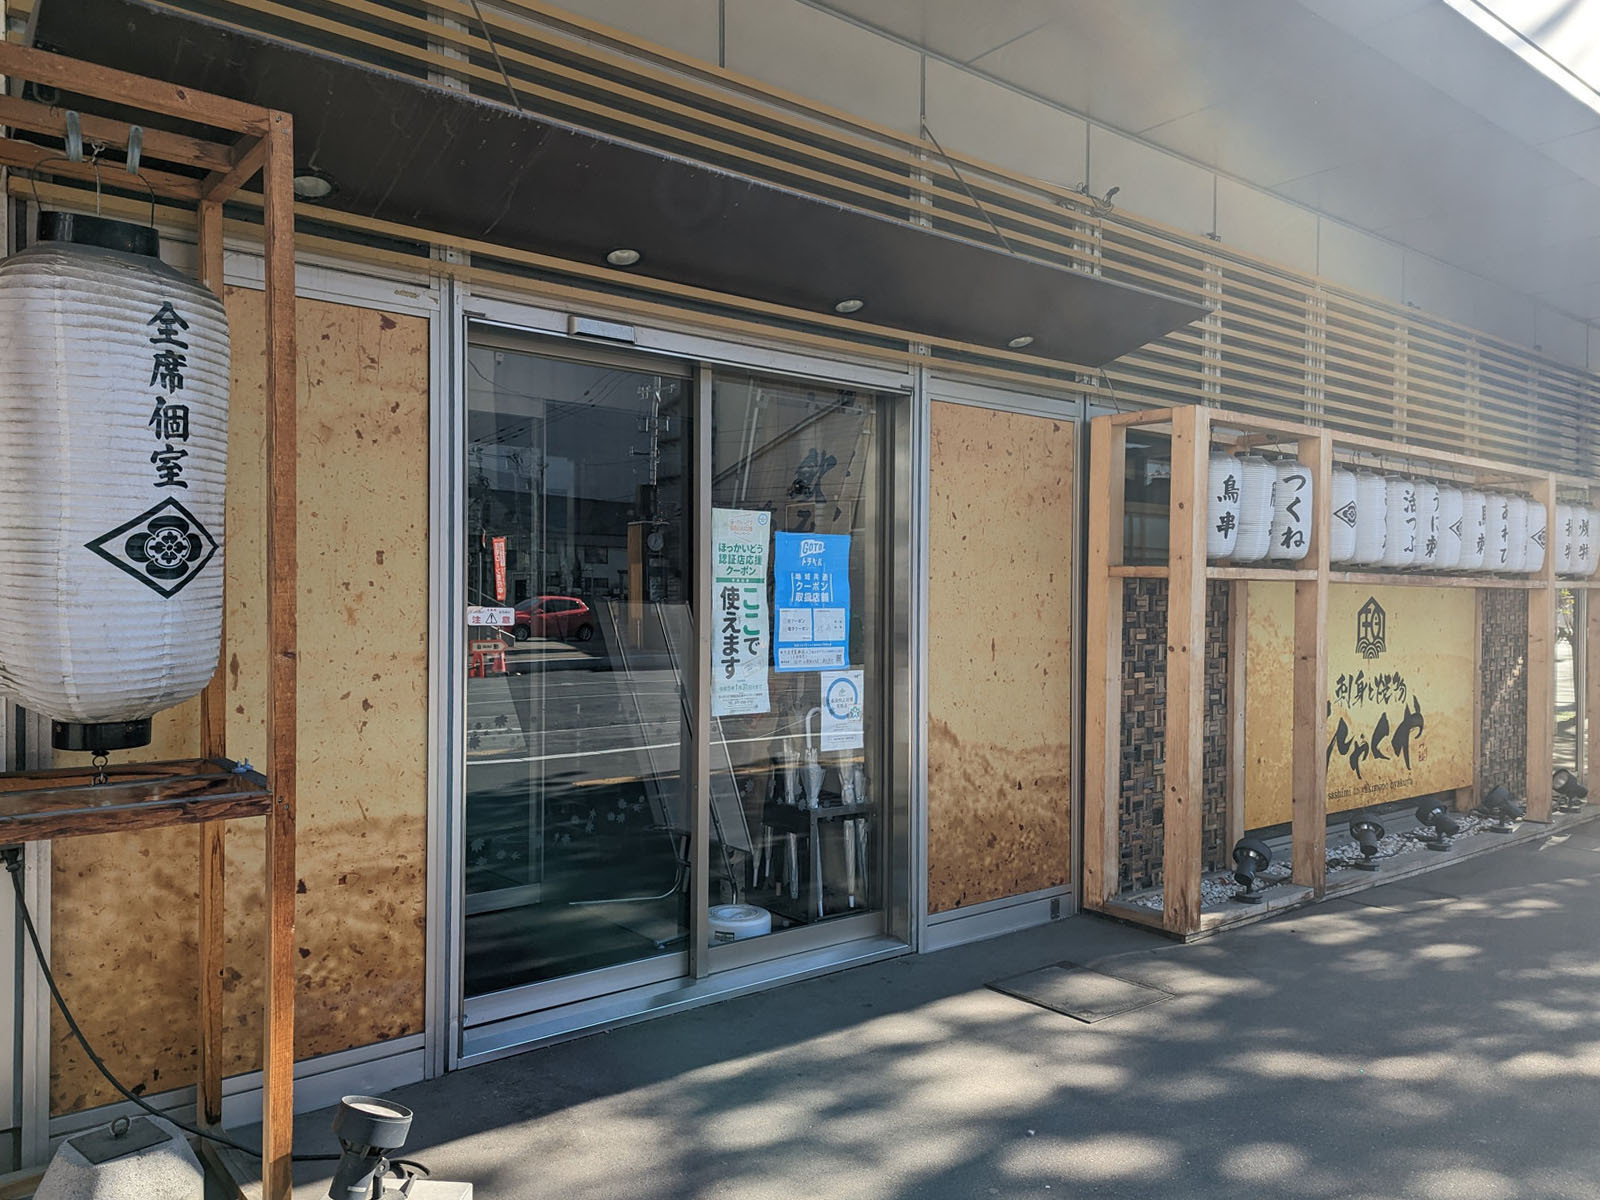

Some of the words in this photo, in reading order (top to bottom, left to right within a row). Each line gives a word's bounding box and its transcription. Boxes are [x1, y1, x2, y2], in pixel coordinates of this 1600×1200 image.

[147, 301, 190, 489] 全席個室
[1216, 474, 1240, 540] 鳥串
[1280, 474, 1307, 549] つくね
[718, 543, 764, 554] ほっかいどう
[718, 554, 763, 565] 認証店応援
[801, 557, 823, 567] トラベル
[726, 566, 757, 576] クーポン
[796, 581, 829, 592] クーポン
[720, 586, 741, 680] 使えます
[743, 587, 760, 656] ここで
